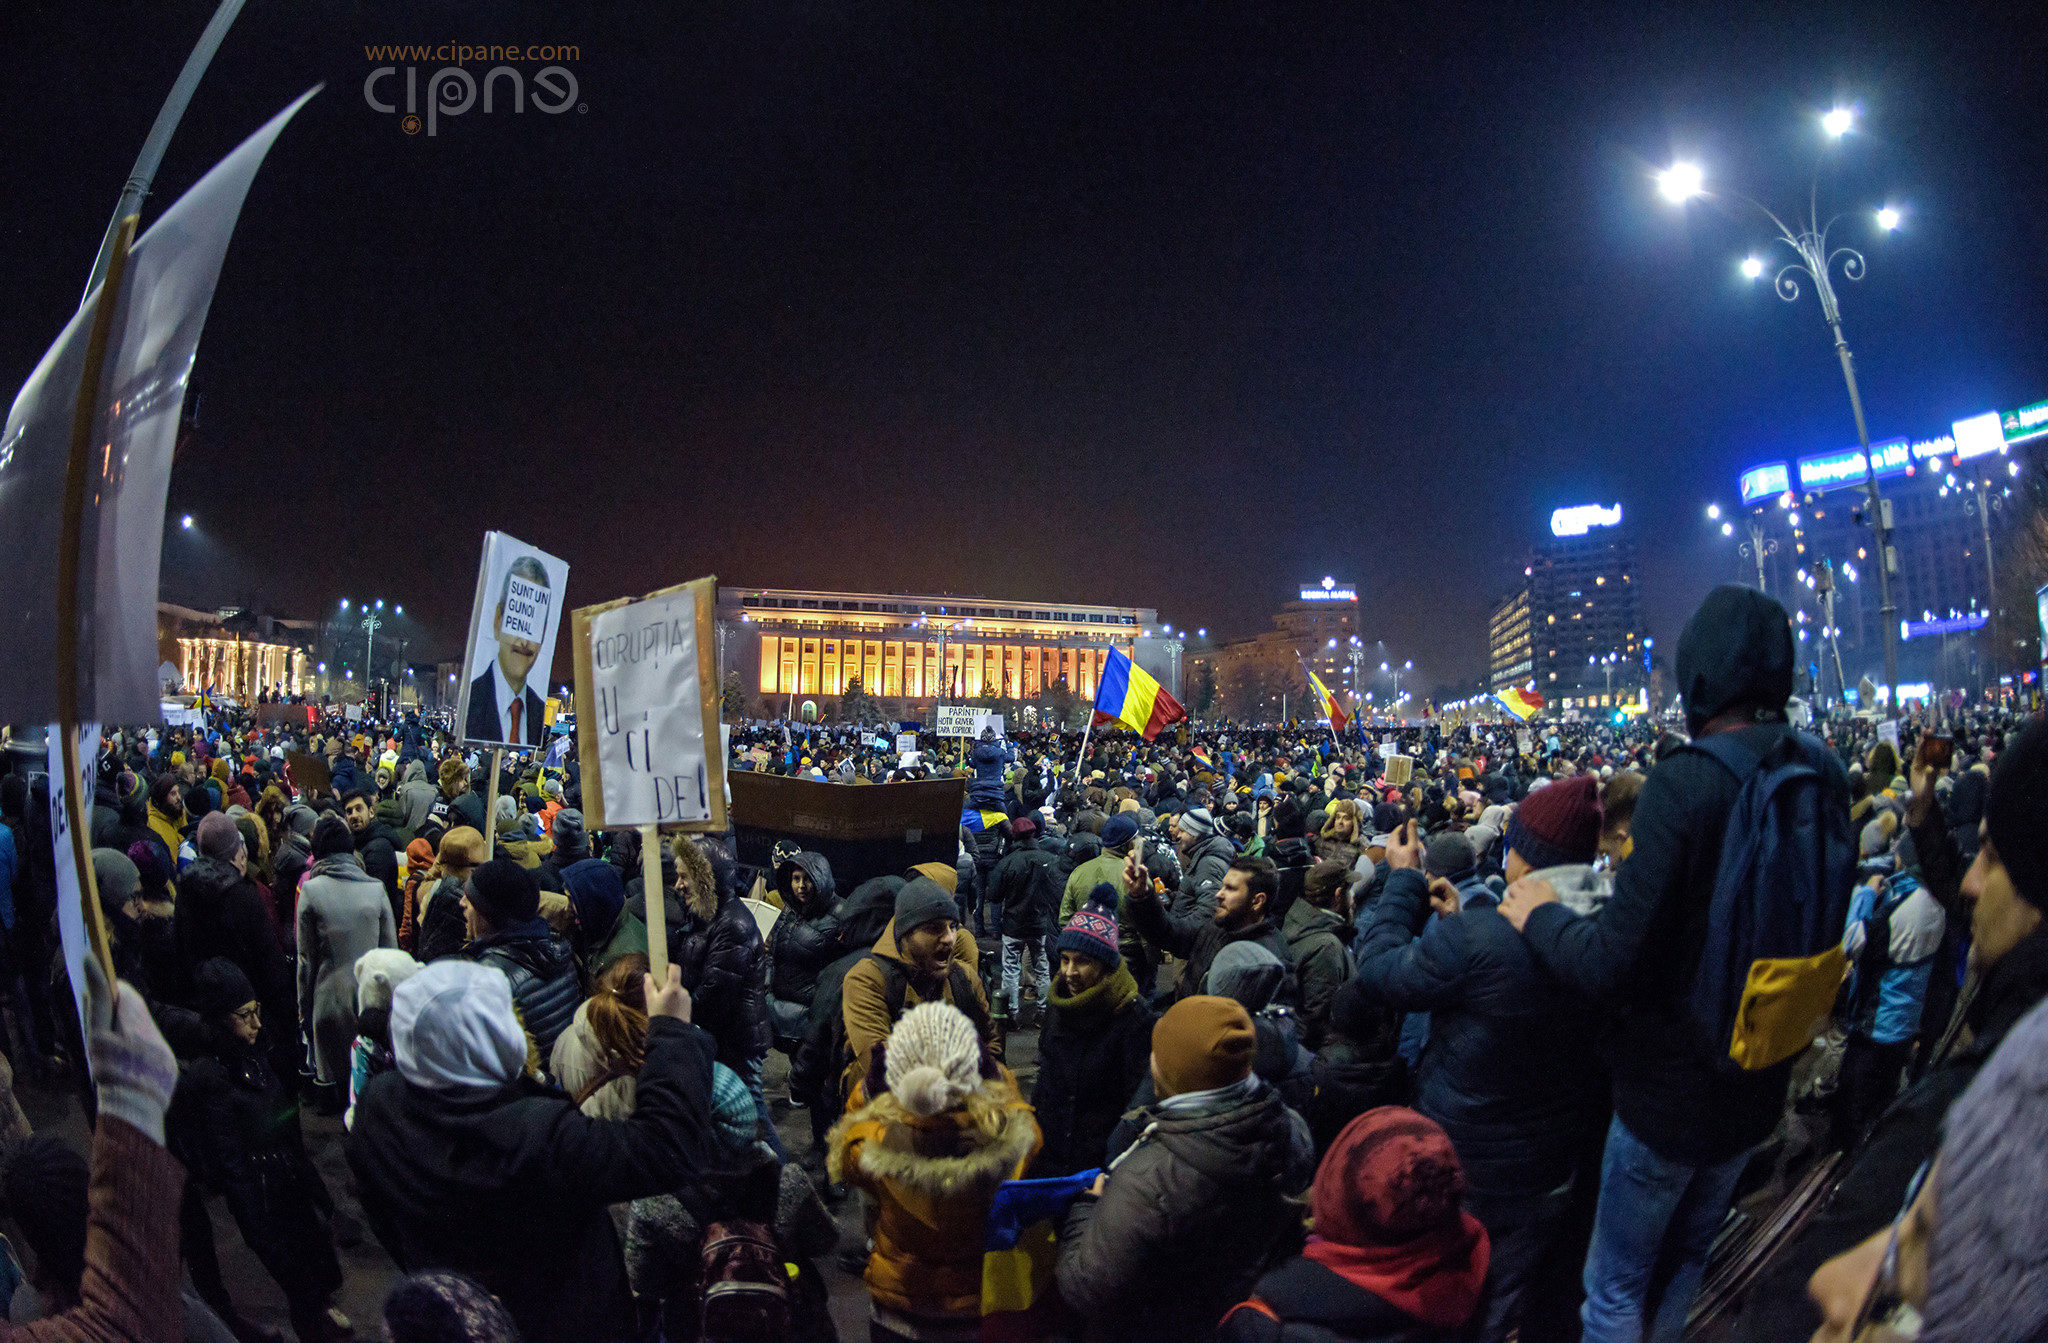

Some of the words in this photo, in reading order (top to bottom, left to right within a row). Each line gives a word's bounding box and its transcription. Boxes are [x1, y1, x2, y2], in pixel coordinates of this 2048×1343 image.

[511, 580, 535, 600] SUNT
[534, 590, 549, 605] UN
[508, 598, 536, 619] GUNOI
[505, 615, 533, 636] PENAL
[602, 685, 620, 735] U
